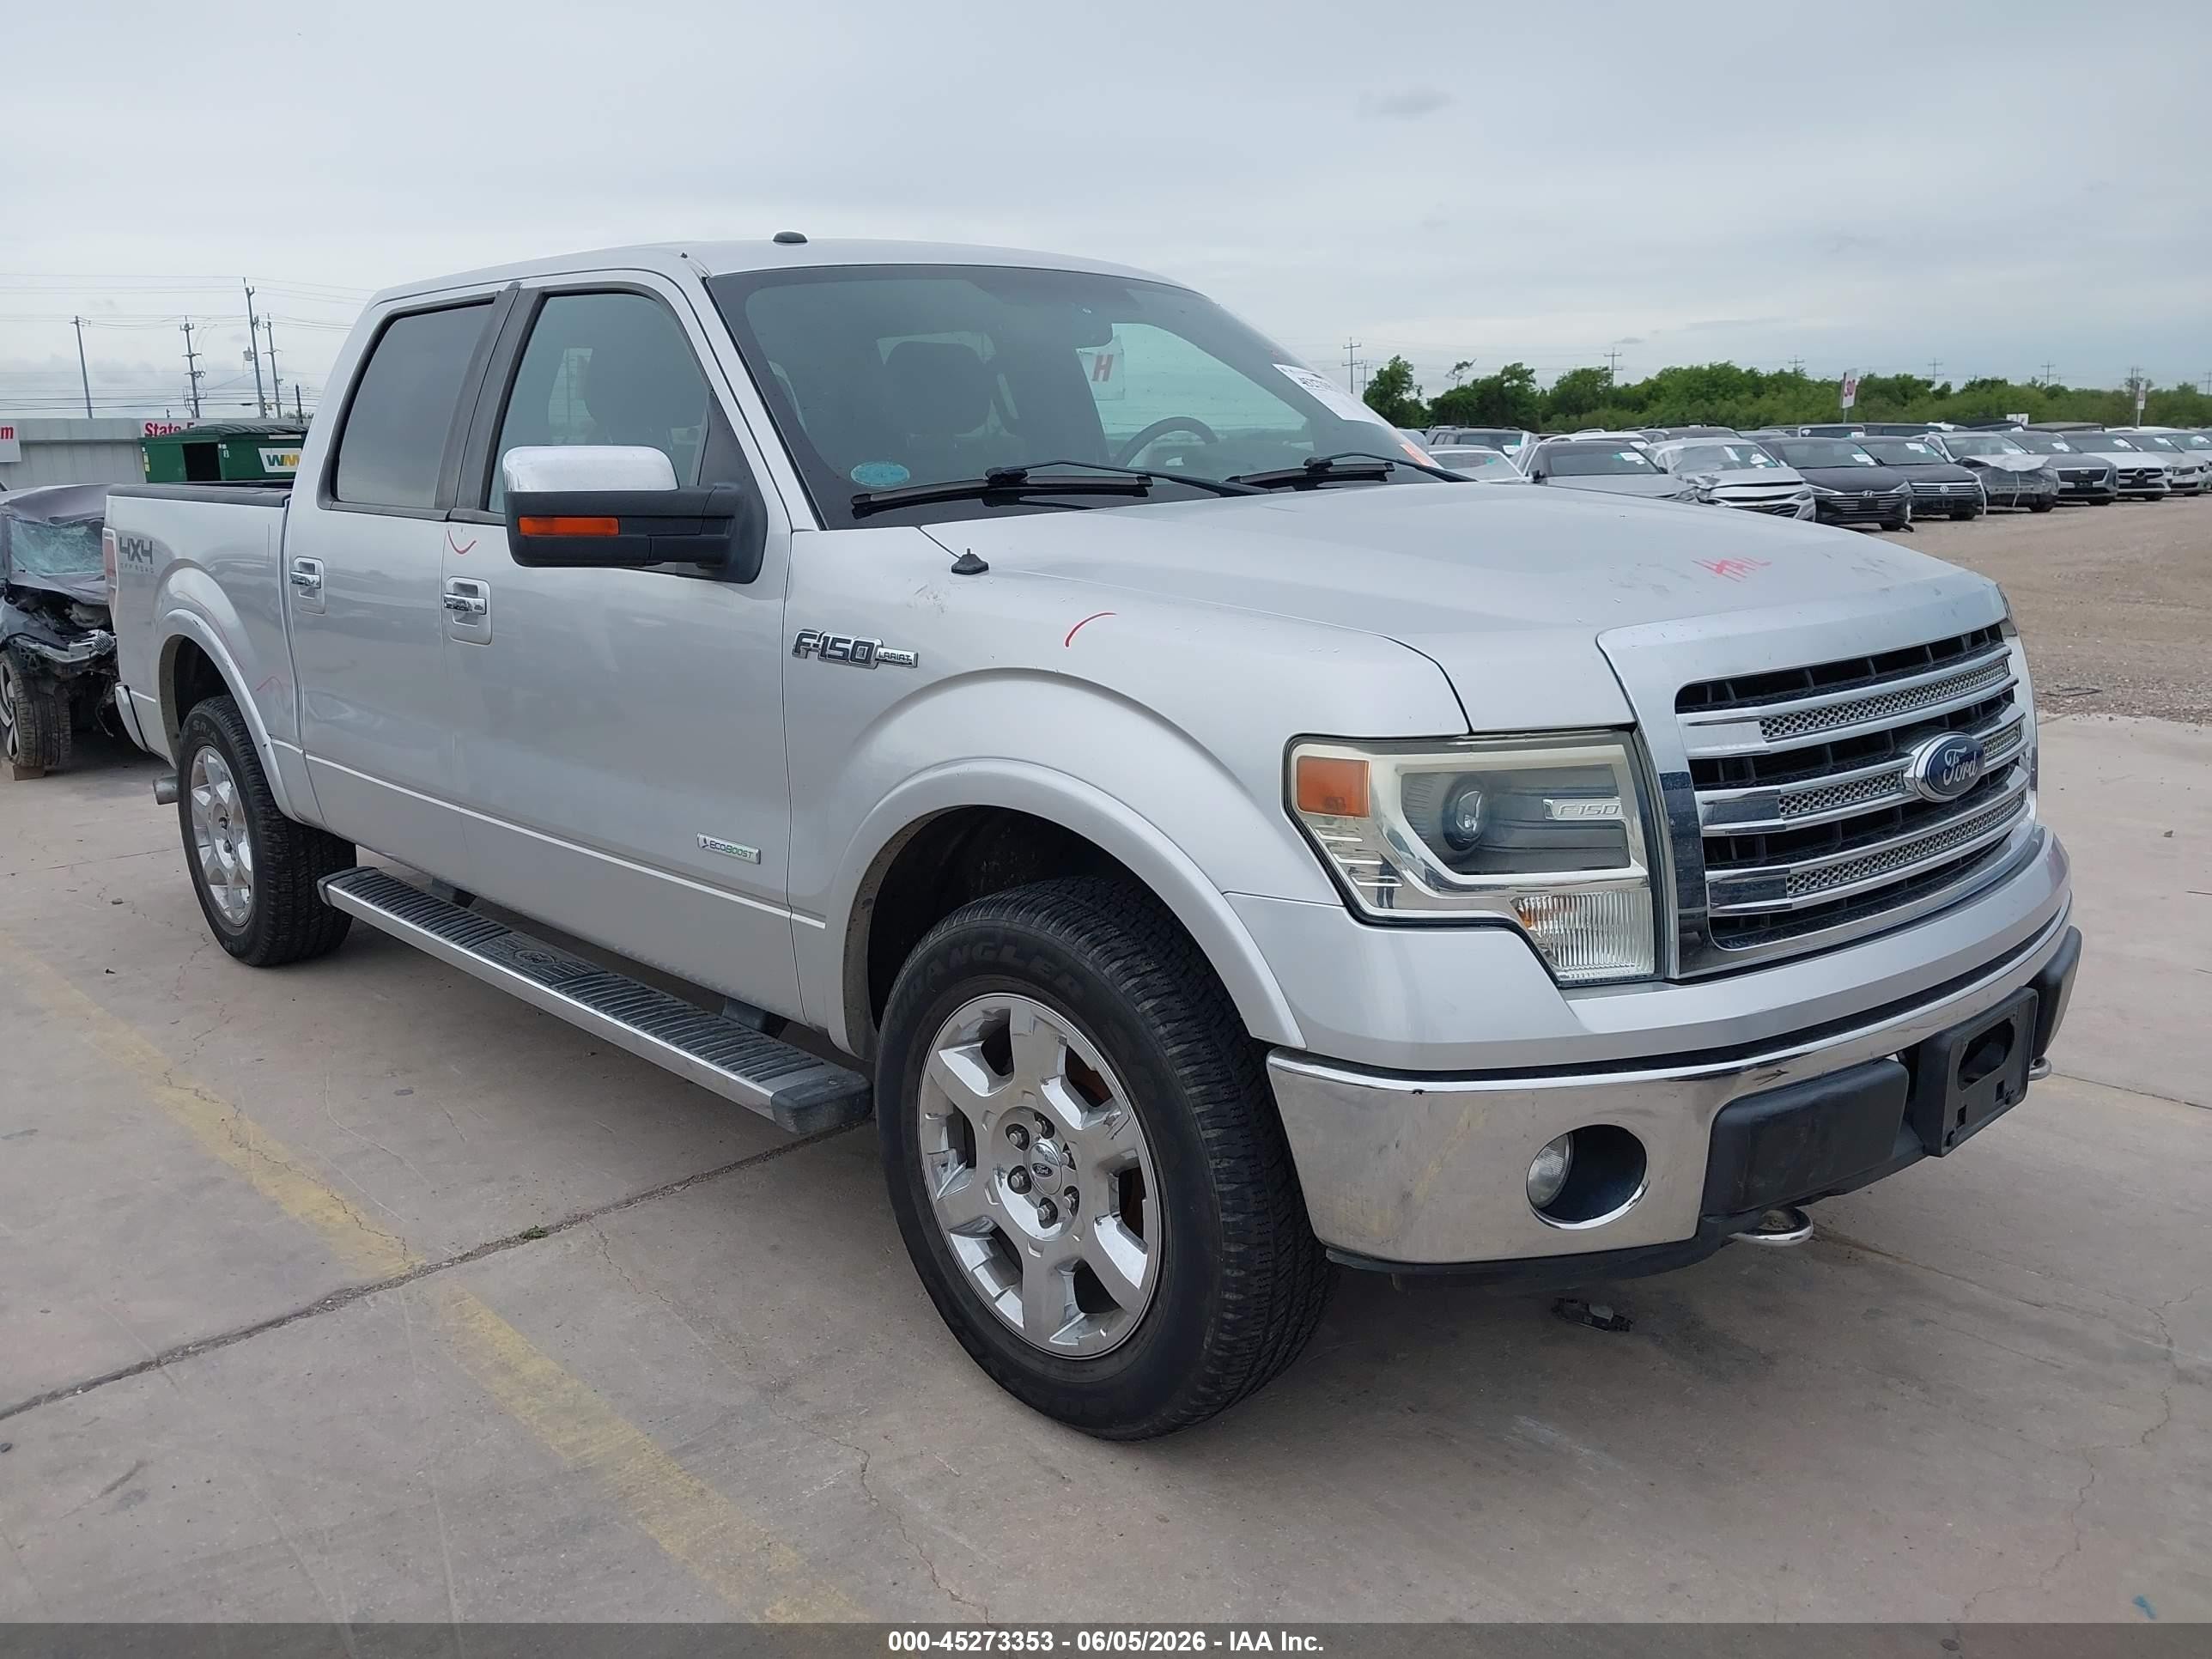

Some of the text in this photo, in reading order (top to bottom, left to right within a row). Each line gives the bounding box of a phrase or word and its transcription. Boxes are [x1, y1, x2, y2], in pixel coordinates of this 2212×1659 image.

[1091, 354, 1114, 381] H
[265, 454, 301, 467] WM
[793, 632, 913, 665] F-150 LARIAT
[1942, 745, 1978, 787] Ford
[709, 840, 753, 858] ECOBOOST
[1035, 1165, 1051, 1175] Ford
